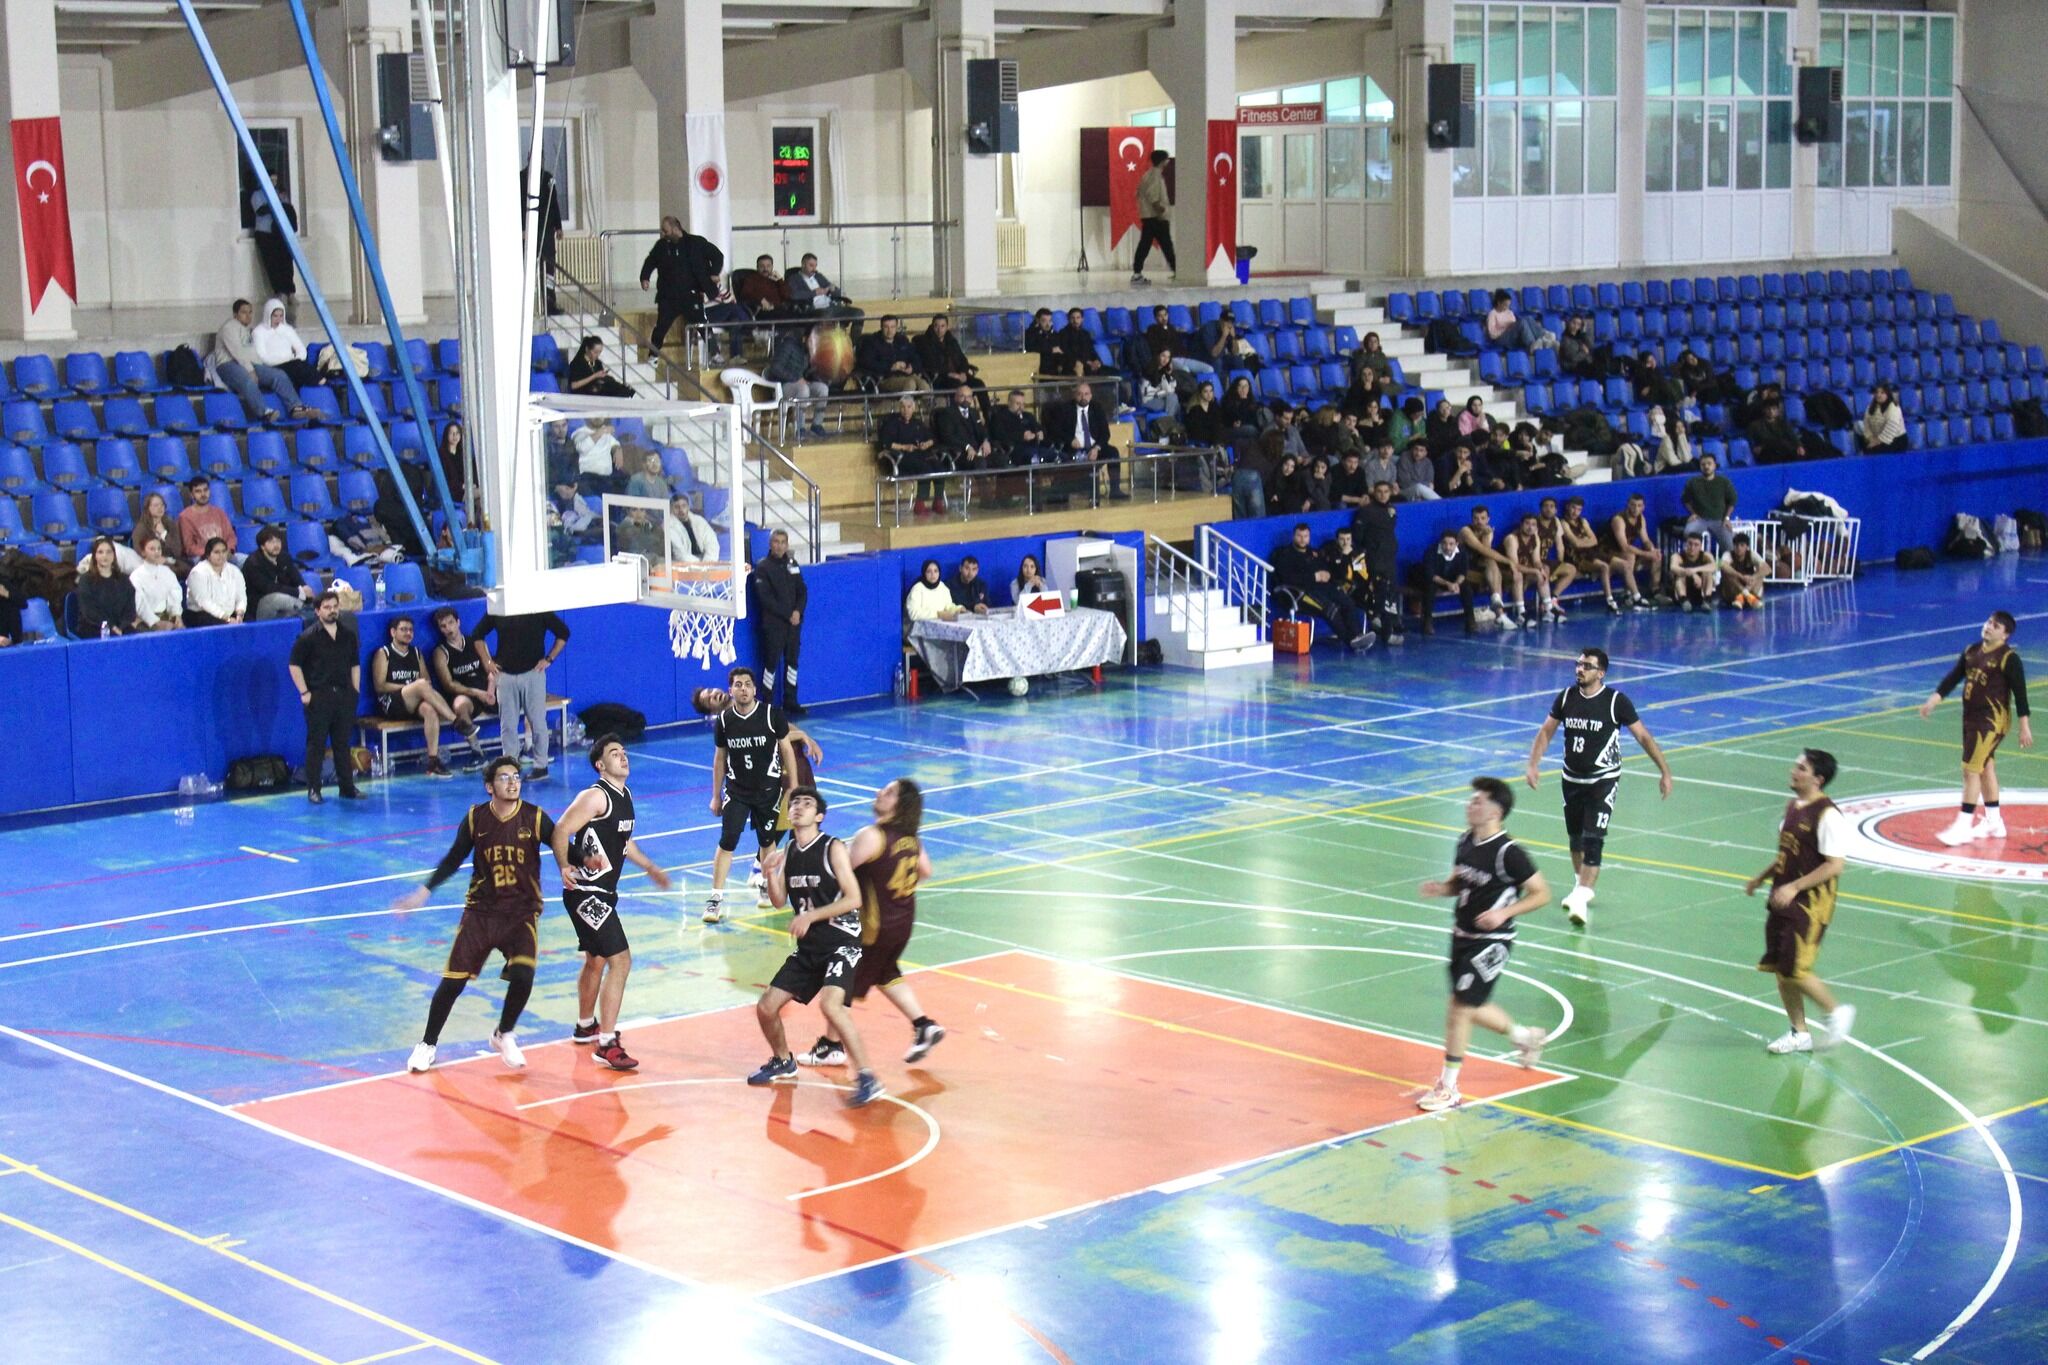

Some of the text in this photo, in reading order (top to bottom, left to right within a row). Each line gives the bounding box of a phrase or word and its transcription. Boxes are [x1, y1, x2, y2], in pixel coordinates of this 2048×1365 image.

[1240, 107, 1318, 122] Fitness Center
[1589, 719, 1603, 732] TIP
[753, 735, 767, 747] TIP
[1572, 736, 1585, 753] 13
[744, 754, 753, 770] 5
[764, 820, 775, 831] 5
[1596, 812, 1609, 829] 13
[484, 845, 526, 864] VETS
